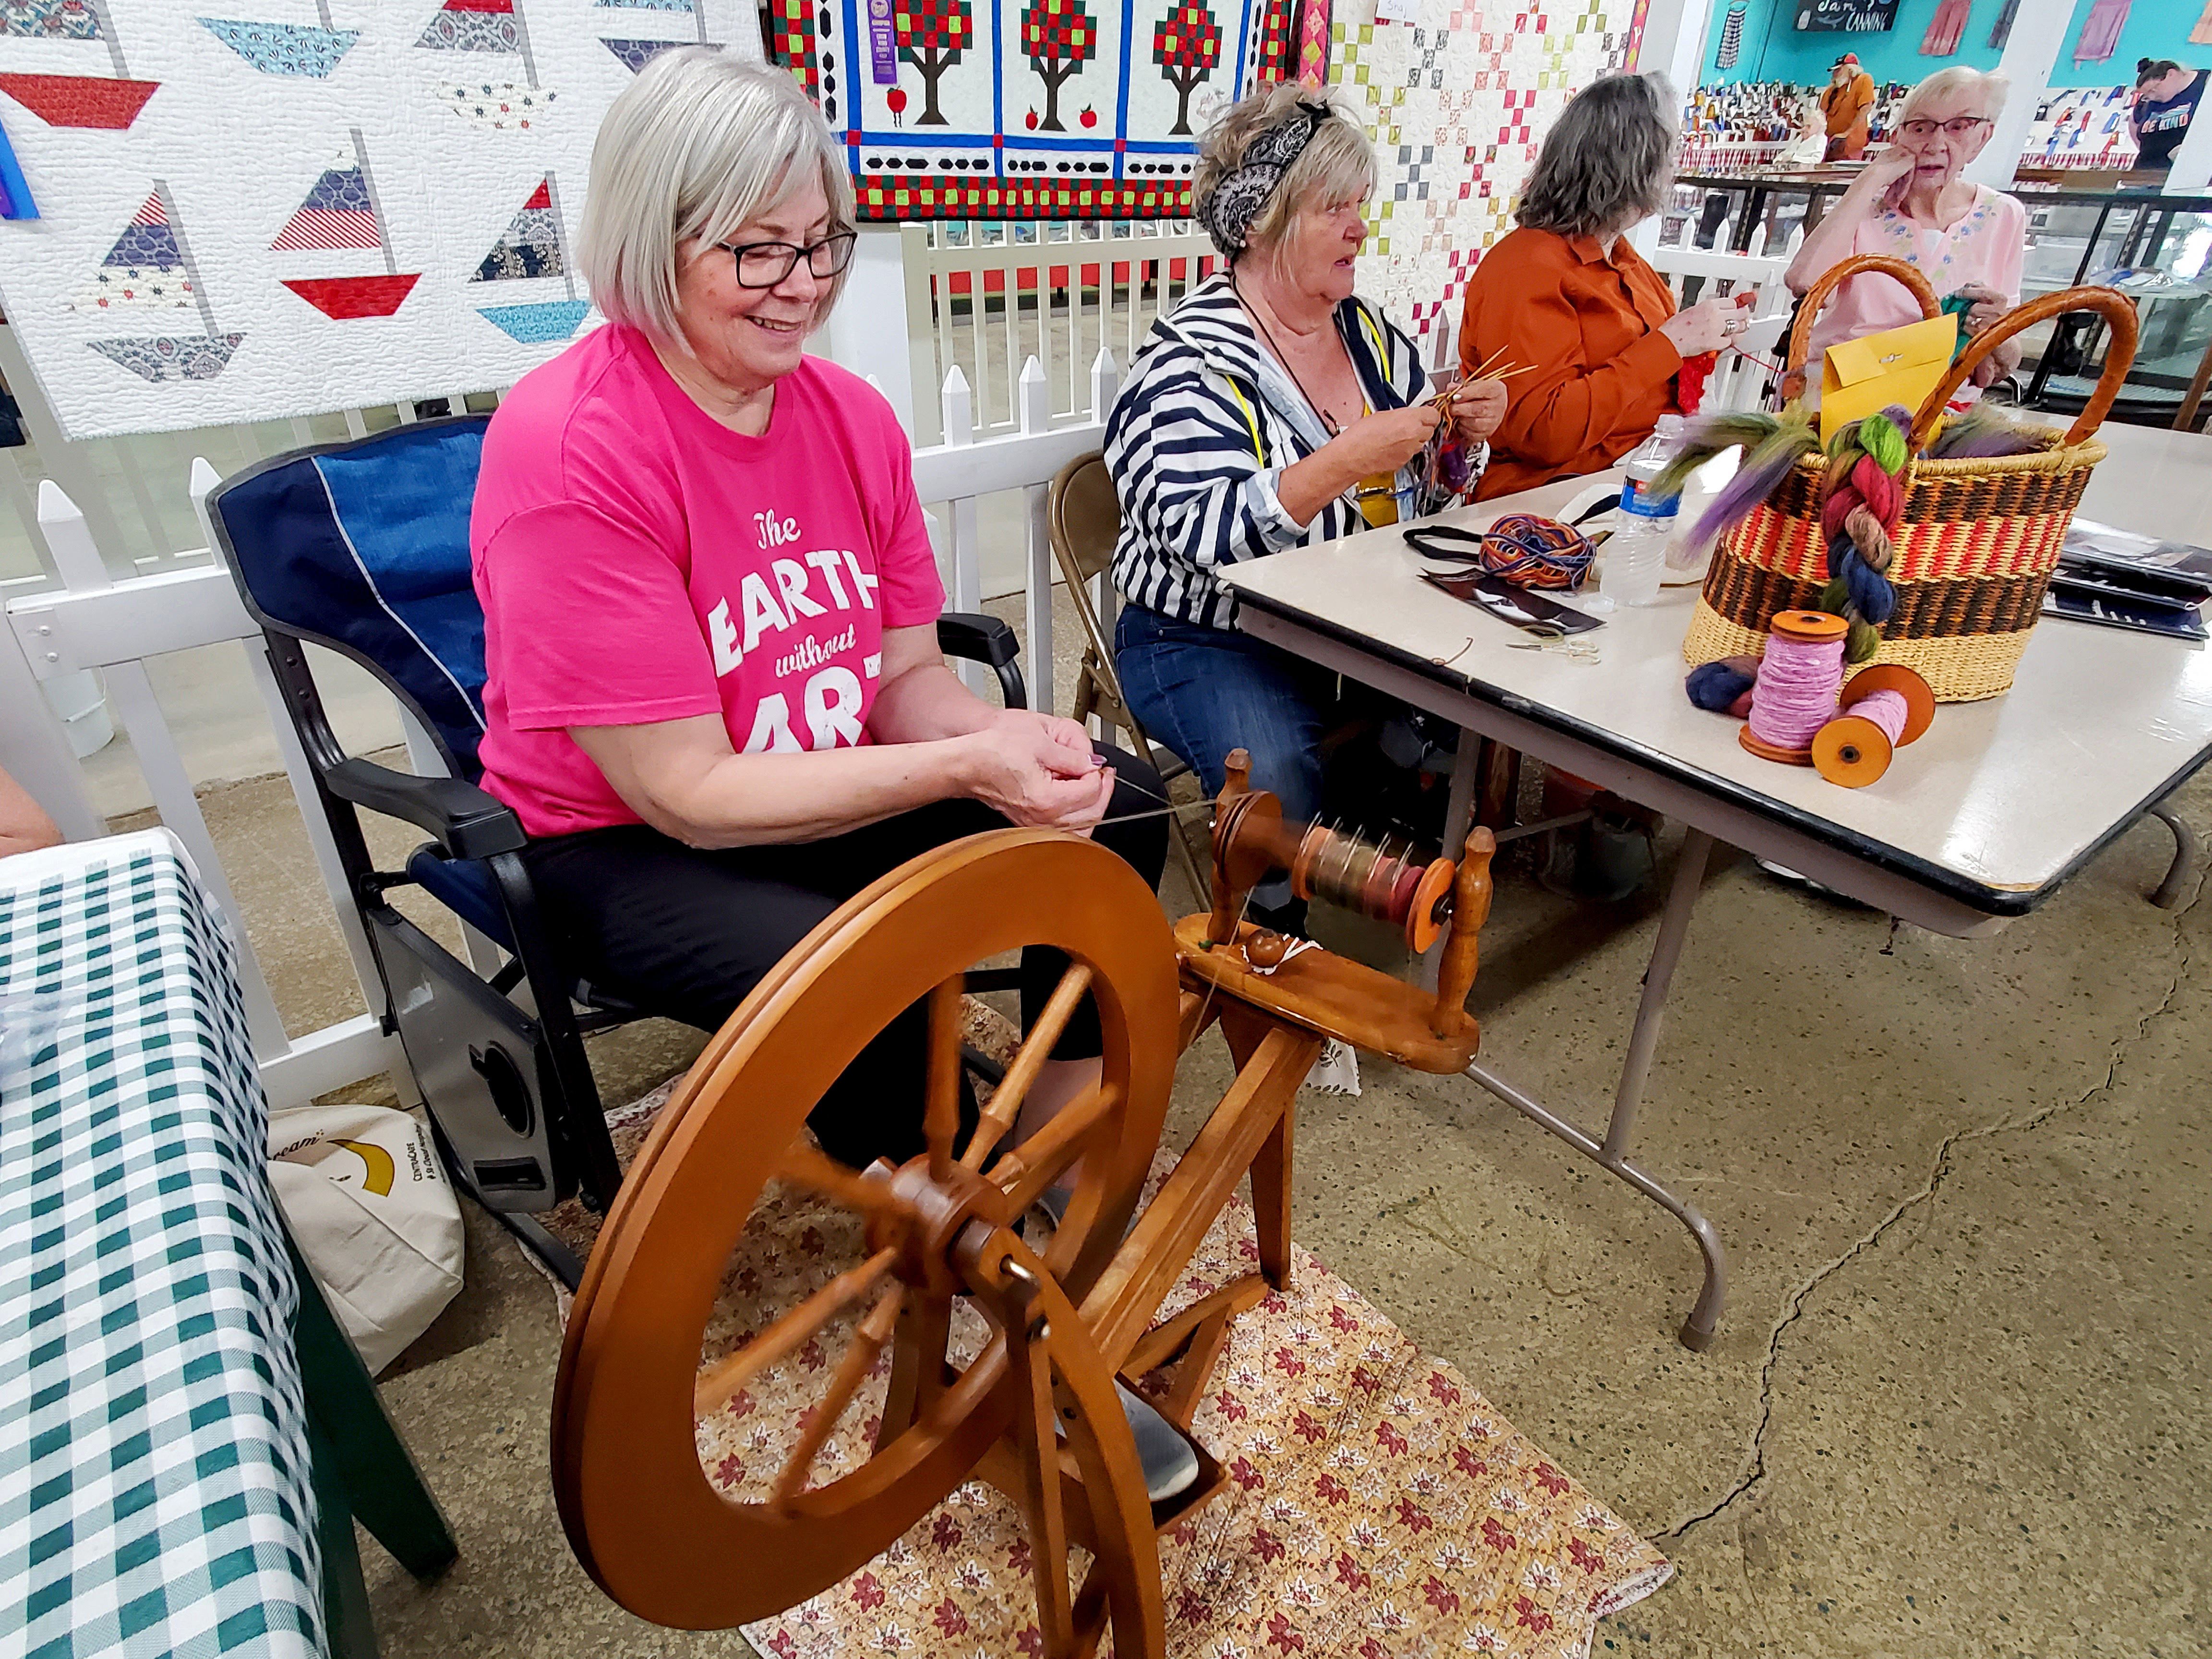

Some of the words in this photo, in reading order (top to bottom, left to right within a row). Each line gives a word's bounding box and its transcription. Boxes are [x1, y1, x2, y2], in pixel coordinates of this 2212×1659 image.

[2141, 120, 2157, 133] BE
[2158, 113, 2189, 131] KIND
[753, 508, 802, 550] The
[774, 622, 857, 678] without
[742, 651, 882, 754] AR
[266, 1137, 320, 1161] ream
